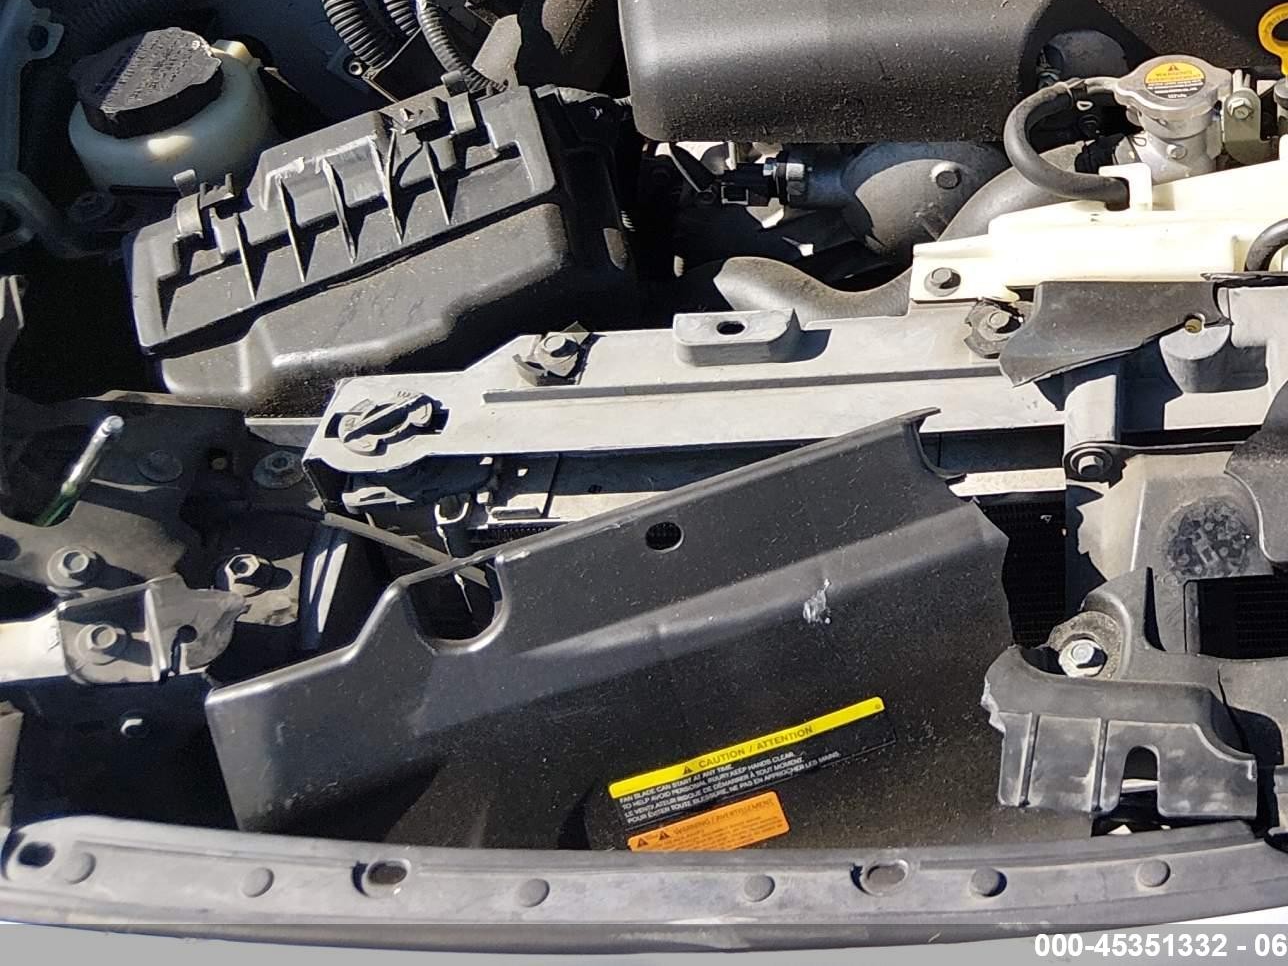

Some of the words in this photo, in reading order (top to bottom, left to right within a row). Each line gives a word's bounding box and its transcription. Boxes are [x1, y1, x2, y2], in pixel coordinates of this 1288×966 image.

[698, 747, 745, 768] CAUTION
[756, 725, 813, 750] ATTENTION
[619, 795, 633, 803] FAN
[634, 788, 656, 799] BLADE
[656, 784, 671, 792] CAN
[633, 797, 650, 807] HELP
[651, 791, 671, 801] AVOID
[627, 813, 647, 824] POUR
